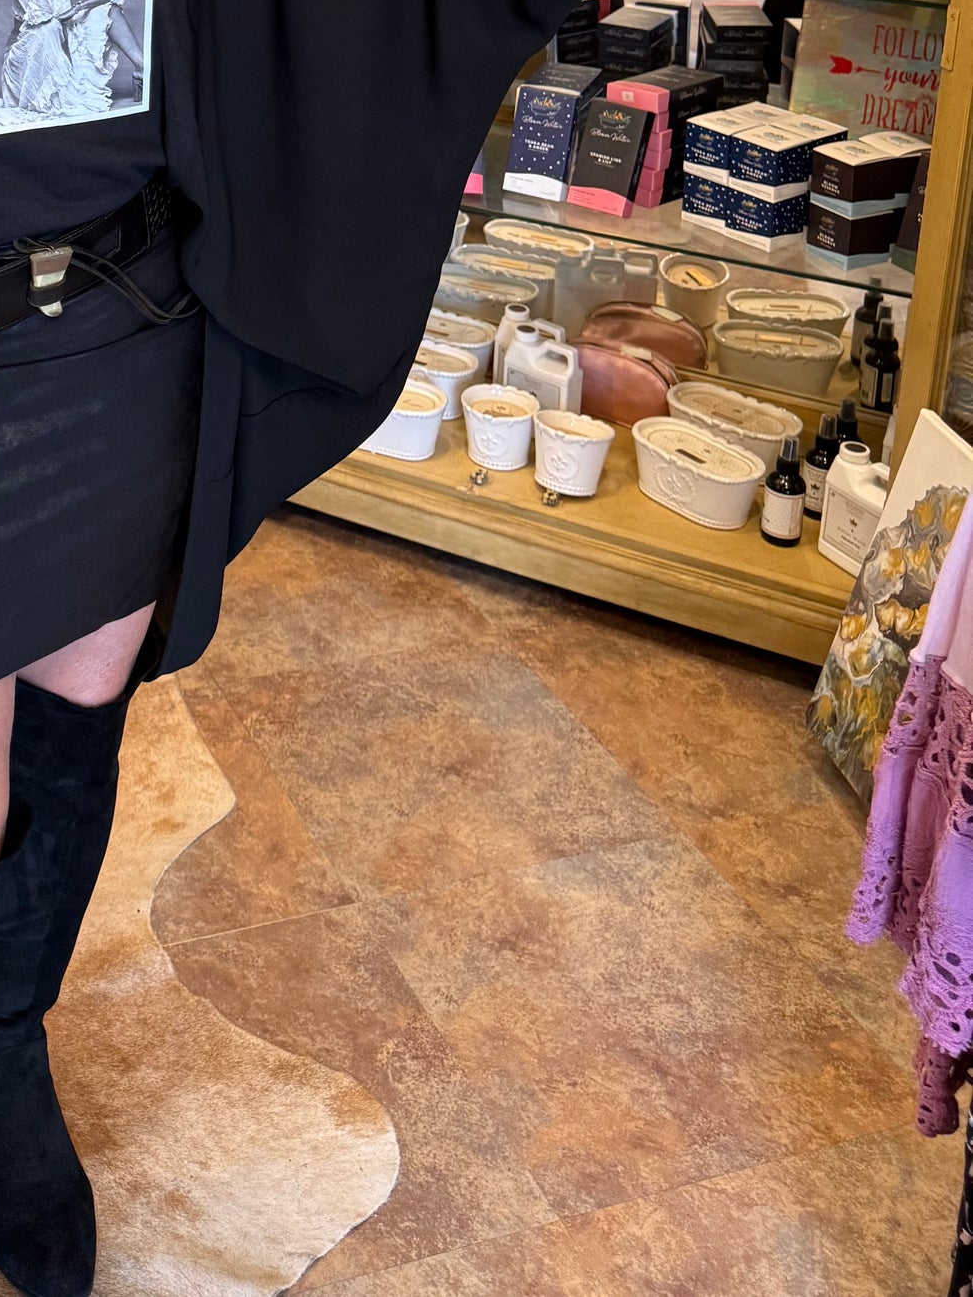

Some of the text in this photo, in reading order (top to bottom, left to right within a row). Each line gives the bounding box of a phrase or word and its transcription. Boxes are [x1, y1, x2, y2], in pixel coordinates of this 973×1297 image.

[872, 24, 944, 62] FOLLO
[883, 66, 940, 92] your
[706, 151, 720, 161] BEAN
[754, 167, 769, 177] BEAN
[705, 201, 719, 211] BEAN
[748, 218, 763, 228] BEAN
